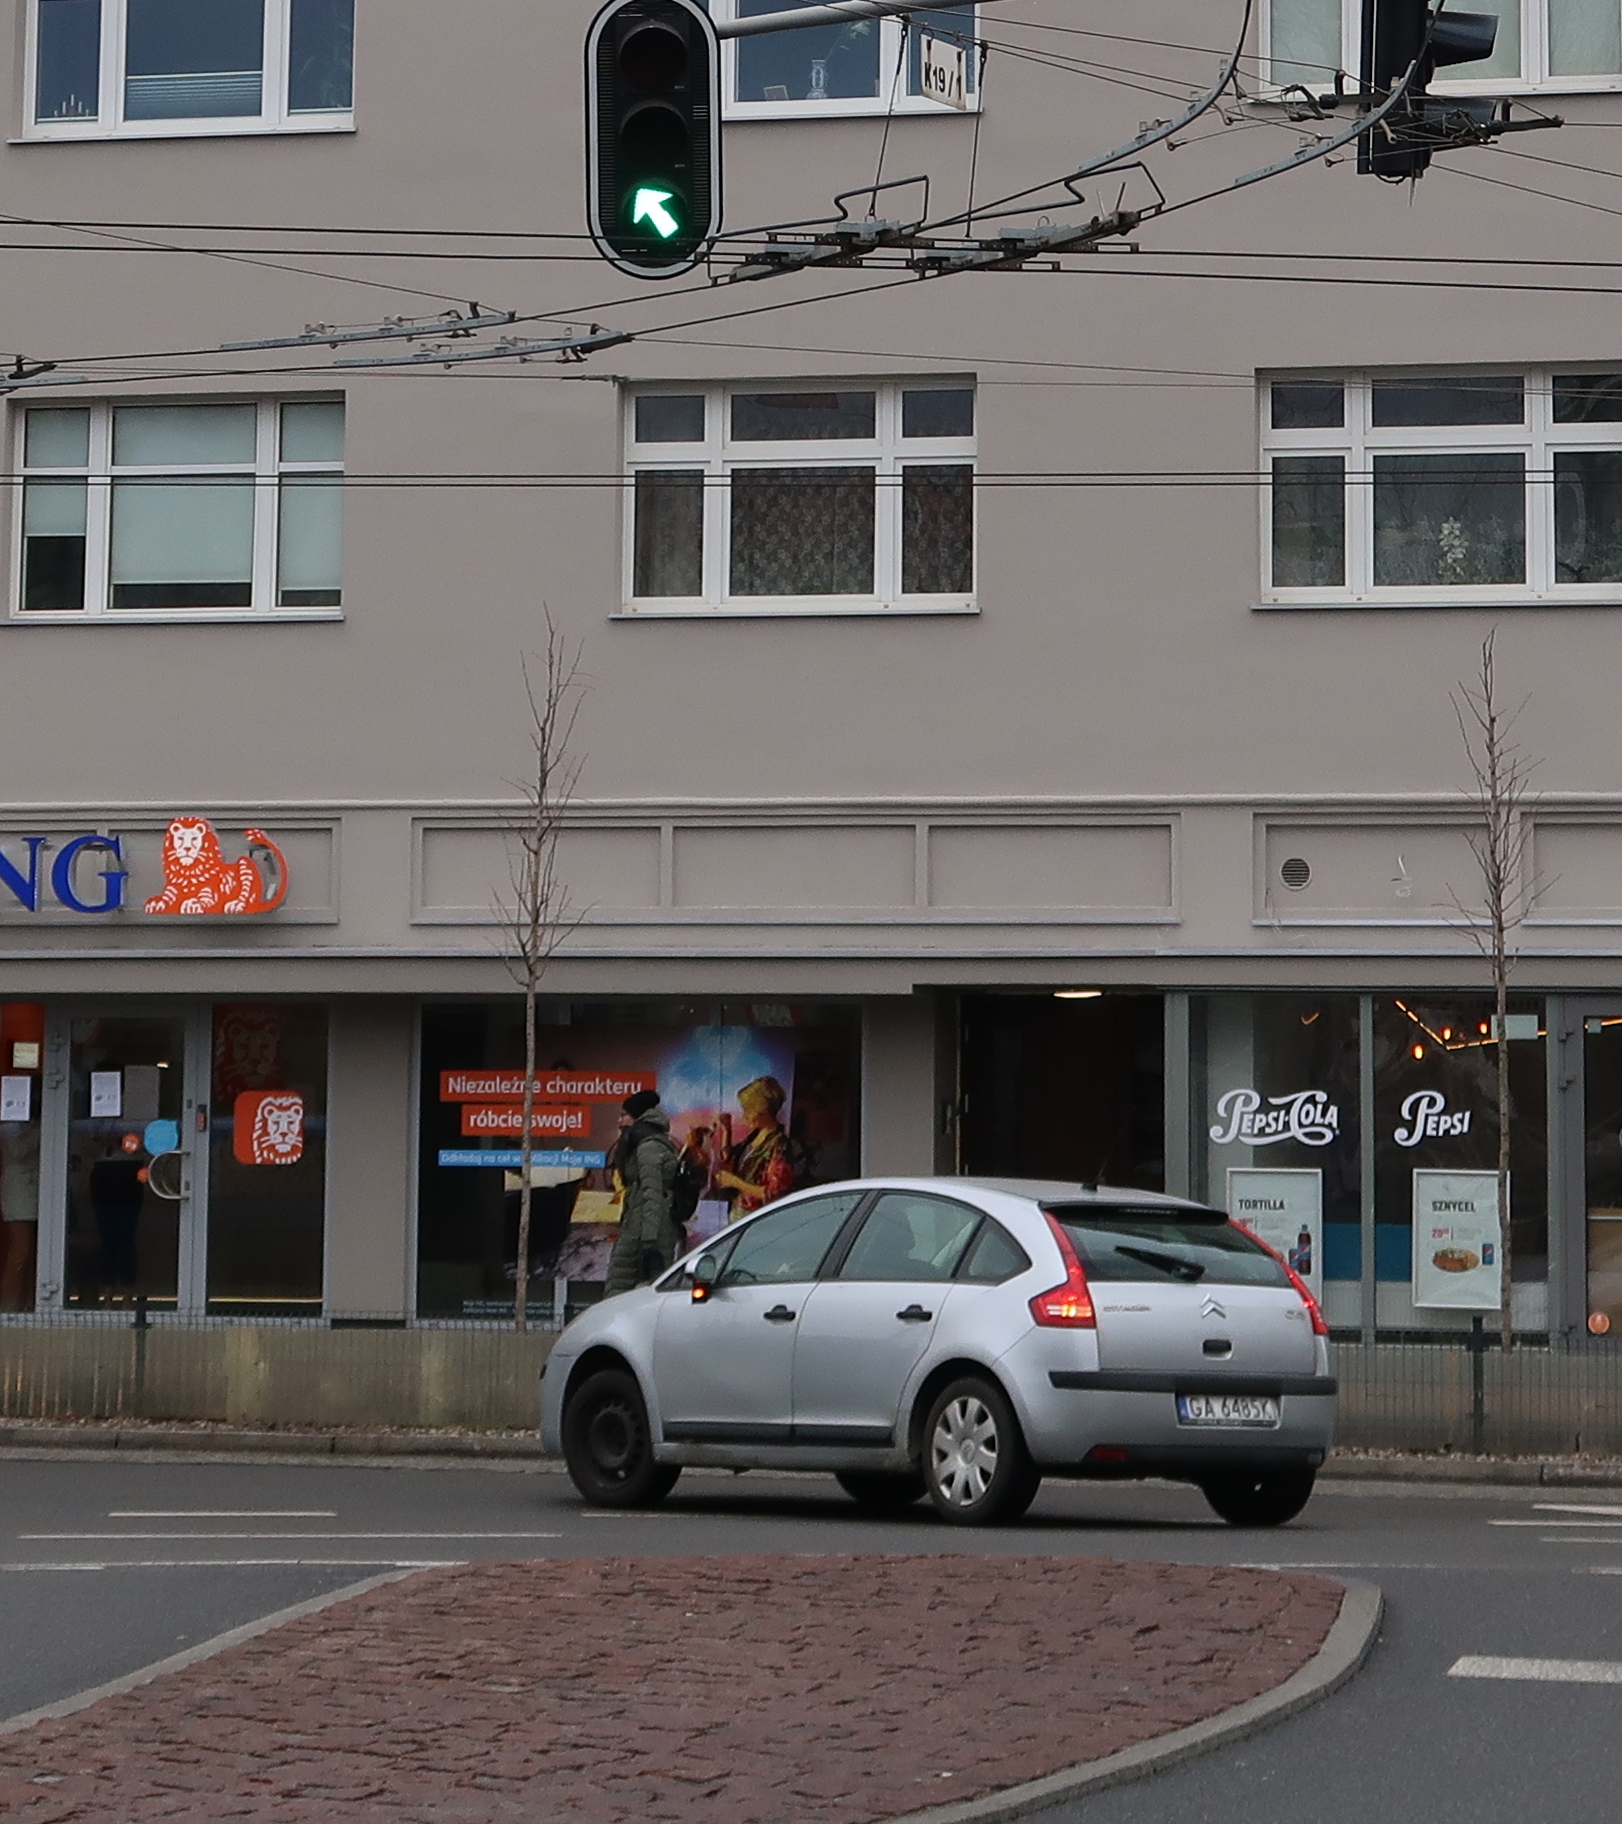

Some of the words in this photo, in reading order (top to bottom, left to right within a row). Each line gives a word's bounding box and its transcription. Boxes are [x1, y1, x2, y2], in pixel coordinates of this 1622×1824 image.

[924, 62, 962, 101] K19/1
[469, 1110, 523, 1128] róbcie
[530, 1112, 583, 1133] swoje!
[1238, 1199, 1285, 1211] TORTILLA
[1432, 1200, 1477, 1213] SZNYCEL
[1188, 1396, 1216, 1419] GA
